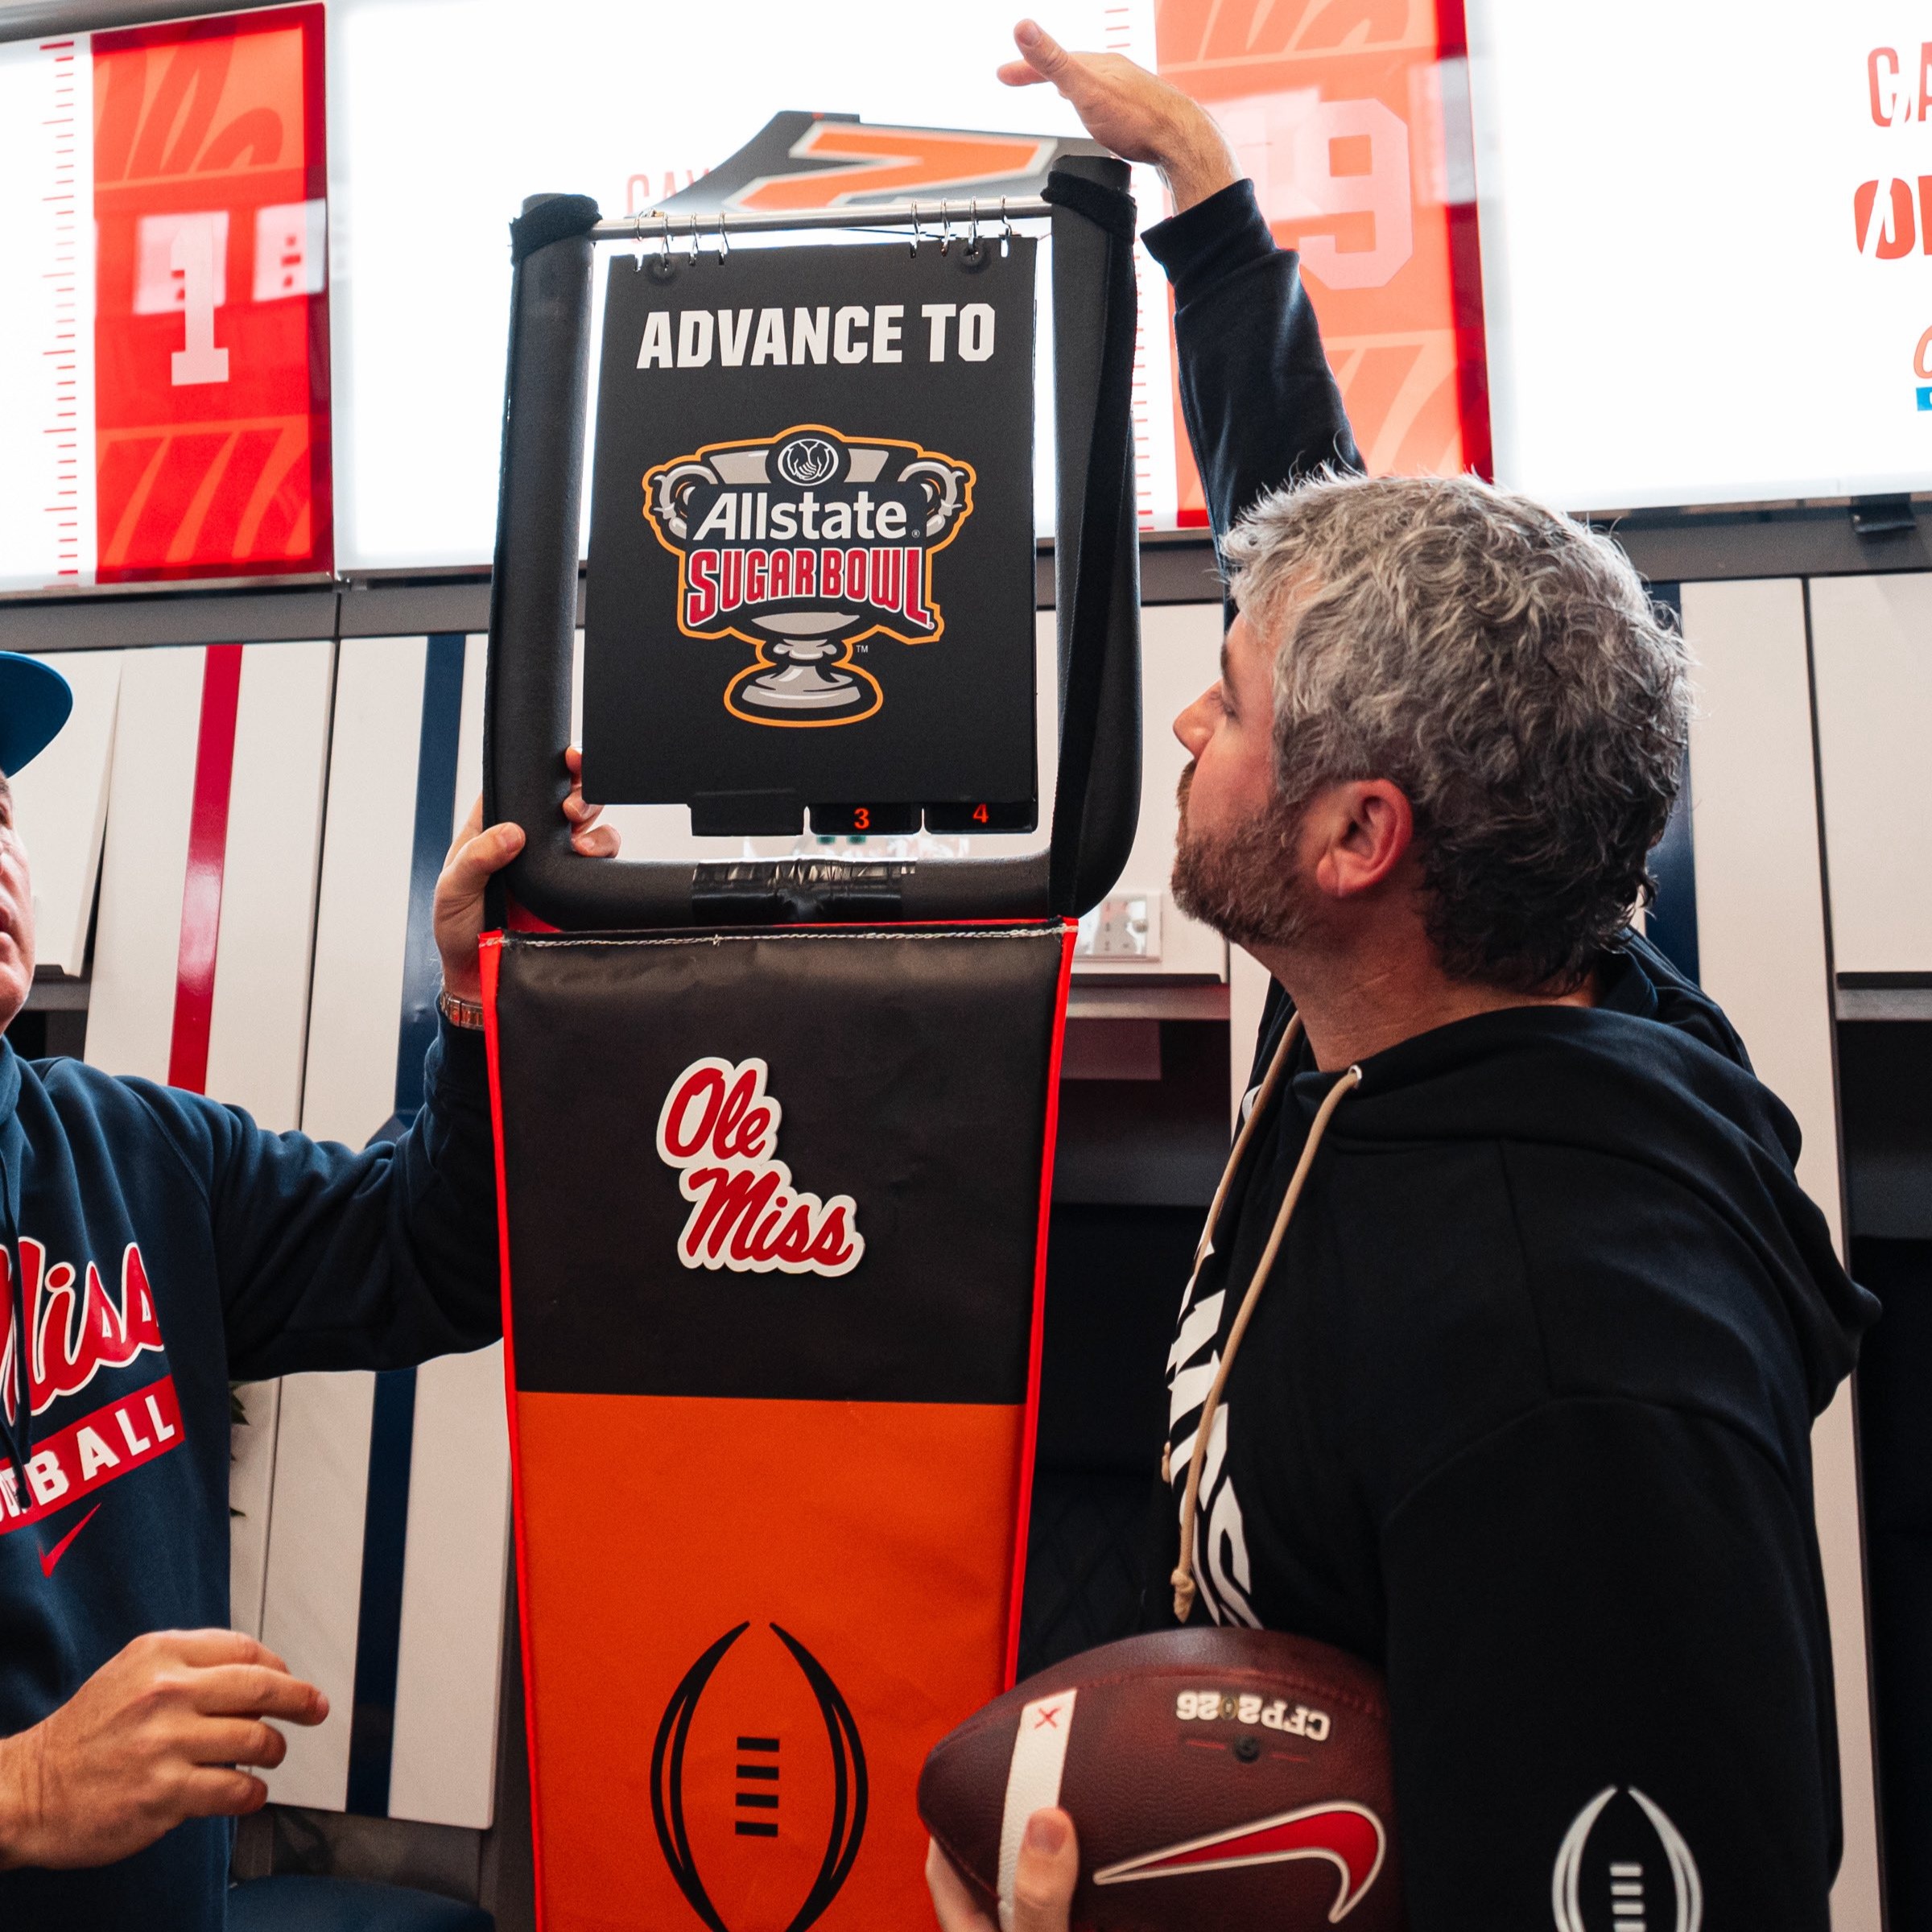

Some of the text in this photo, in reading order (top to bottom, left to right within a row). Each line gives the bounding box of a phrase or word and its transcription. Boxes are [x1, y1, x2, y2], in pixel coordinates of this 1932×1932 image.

[171, 215, 229, 386] 1
[636, 303, 996, 369] ADVANCE TO
[692, 490, 907, 541] Allstate
[687, 547, 931, 629] SUGAR BOWL
[853, 807, 870, 829] 3
[972, 803, 989, 824] 4
[663, 1065, 773, 1162] Ole
[684, 1166, 856, 1267] Miss
